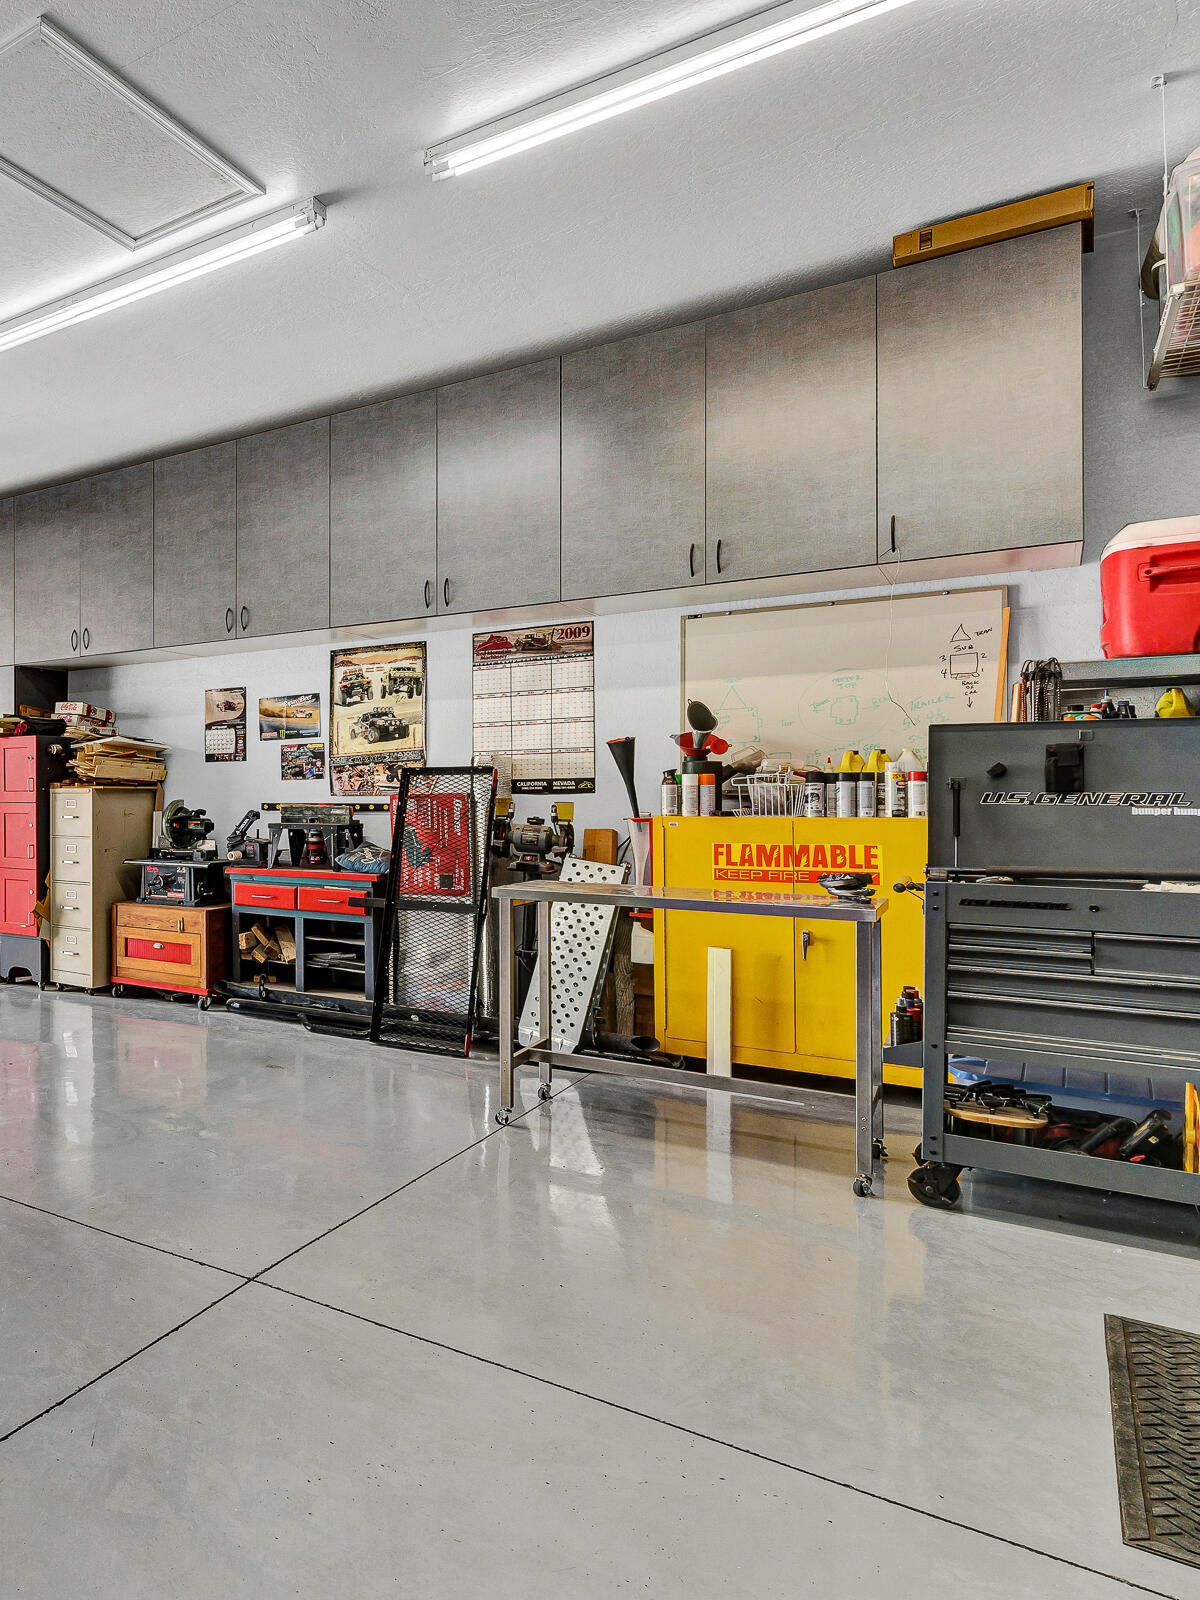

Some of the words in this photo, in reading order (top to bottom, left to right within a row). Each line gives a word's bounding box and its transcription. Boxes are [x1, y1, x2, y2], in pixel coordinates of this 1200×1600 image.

[557, 626, 590, 640] 2009
[940, 668, 947, 678] 4
[979, 792, 1030, 805] U.S.
[1033, 792, 1193, 807] GENERAL
[1132, 807, 1172, 816] bumper
[713, 843, 879, 869] FLAMMABLE
[715, 869, 763, 880] KEEP
[768, 871, 810, 881] FIRE
